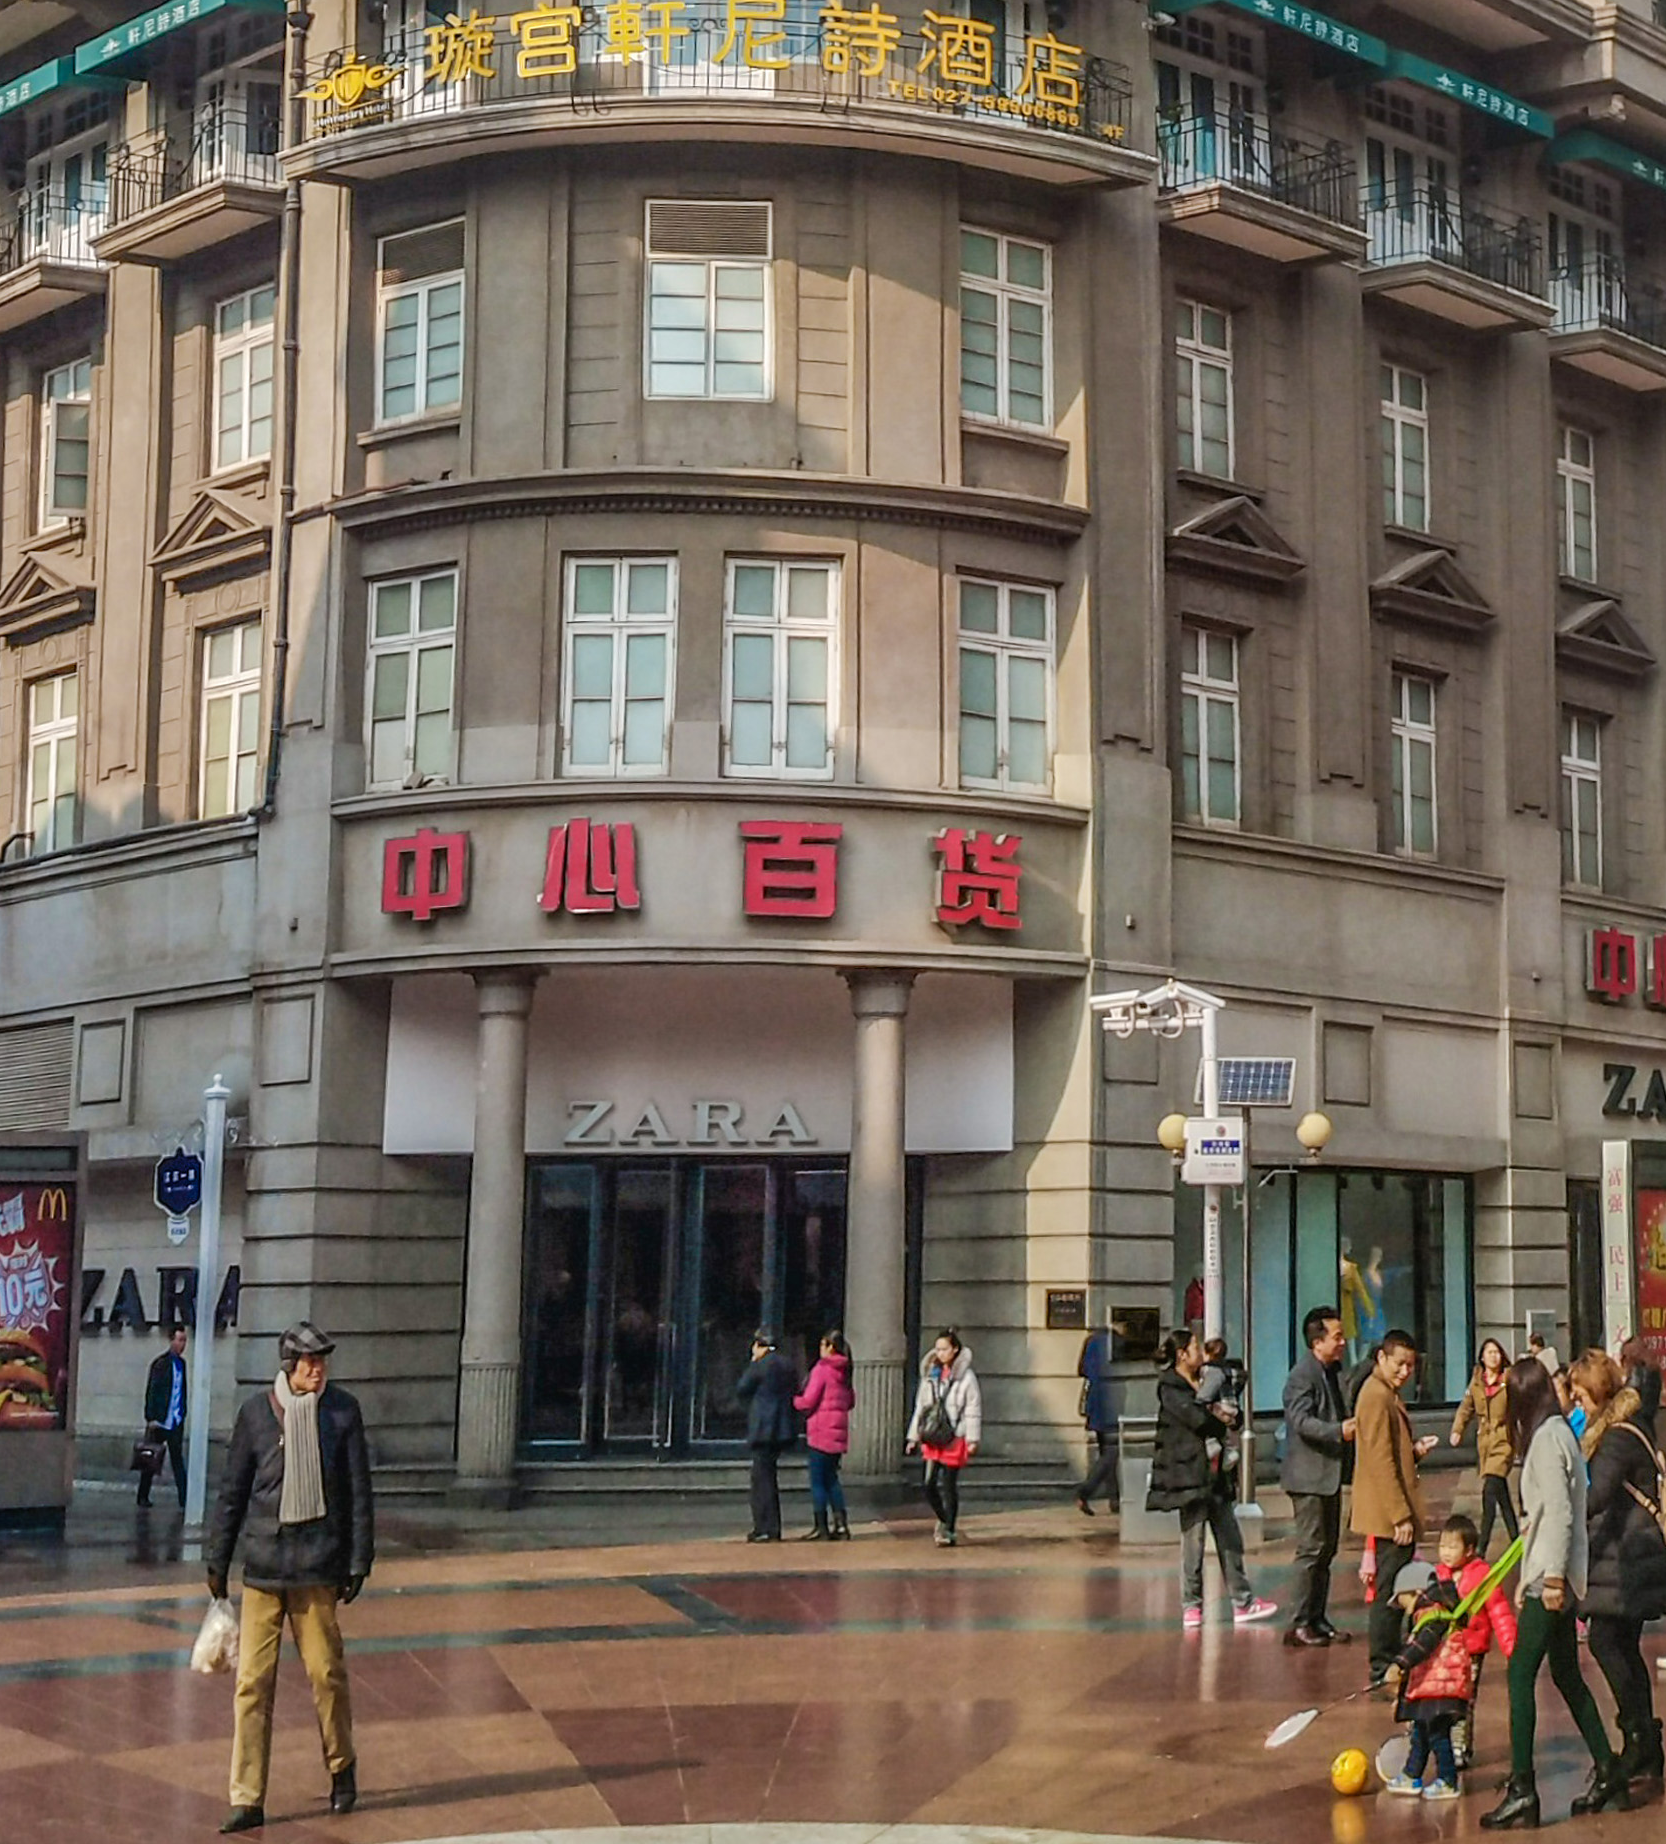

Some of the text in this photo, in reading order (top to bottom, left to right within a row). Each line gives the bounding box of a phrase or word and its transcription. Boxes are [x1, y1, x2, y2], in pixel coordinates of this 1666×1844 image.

[888, 80, 928, 100] TEL
[381, 818, 1023, 929] 中心百货
[564, 1100, 819, 1147] ZARA
